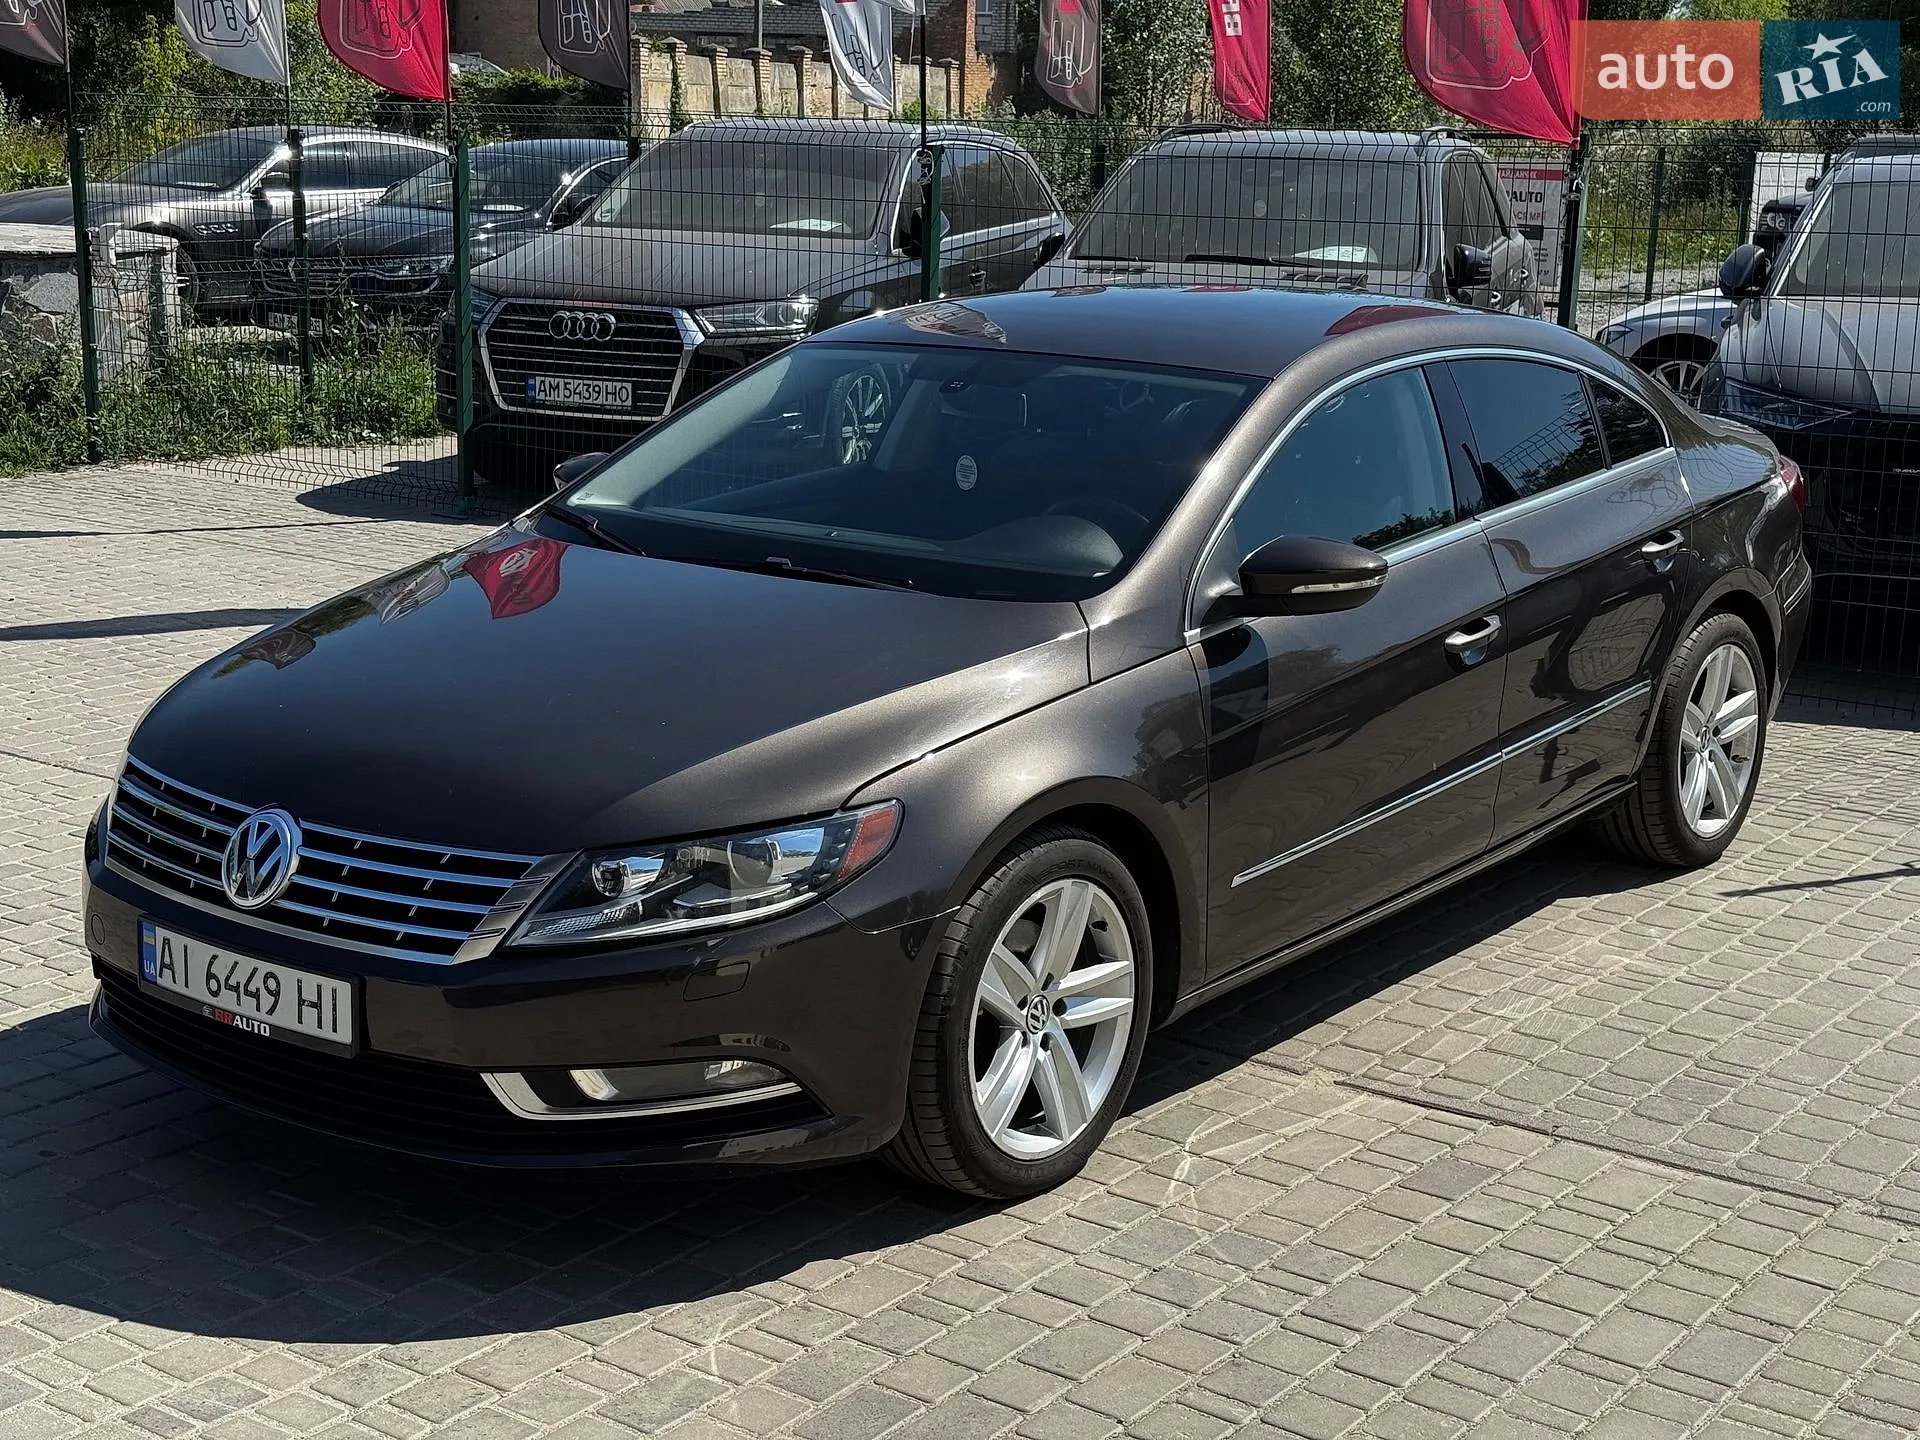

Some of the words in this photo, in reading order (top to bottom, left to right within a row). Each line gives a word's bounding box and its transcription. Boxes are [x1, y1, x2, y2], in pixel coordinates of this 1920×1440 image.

[537, 380, 560, 399] AM
[563, 381, 602, 401] 5439
[604, 384, 630, 404] HO
[143, 959, 156, 976] UA
[158, 935, 190, 989] AI
[205, 954, 281, 1016] 6449
[296, 976, 338, 1034] HI
